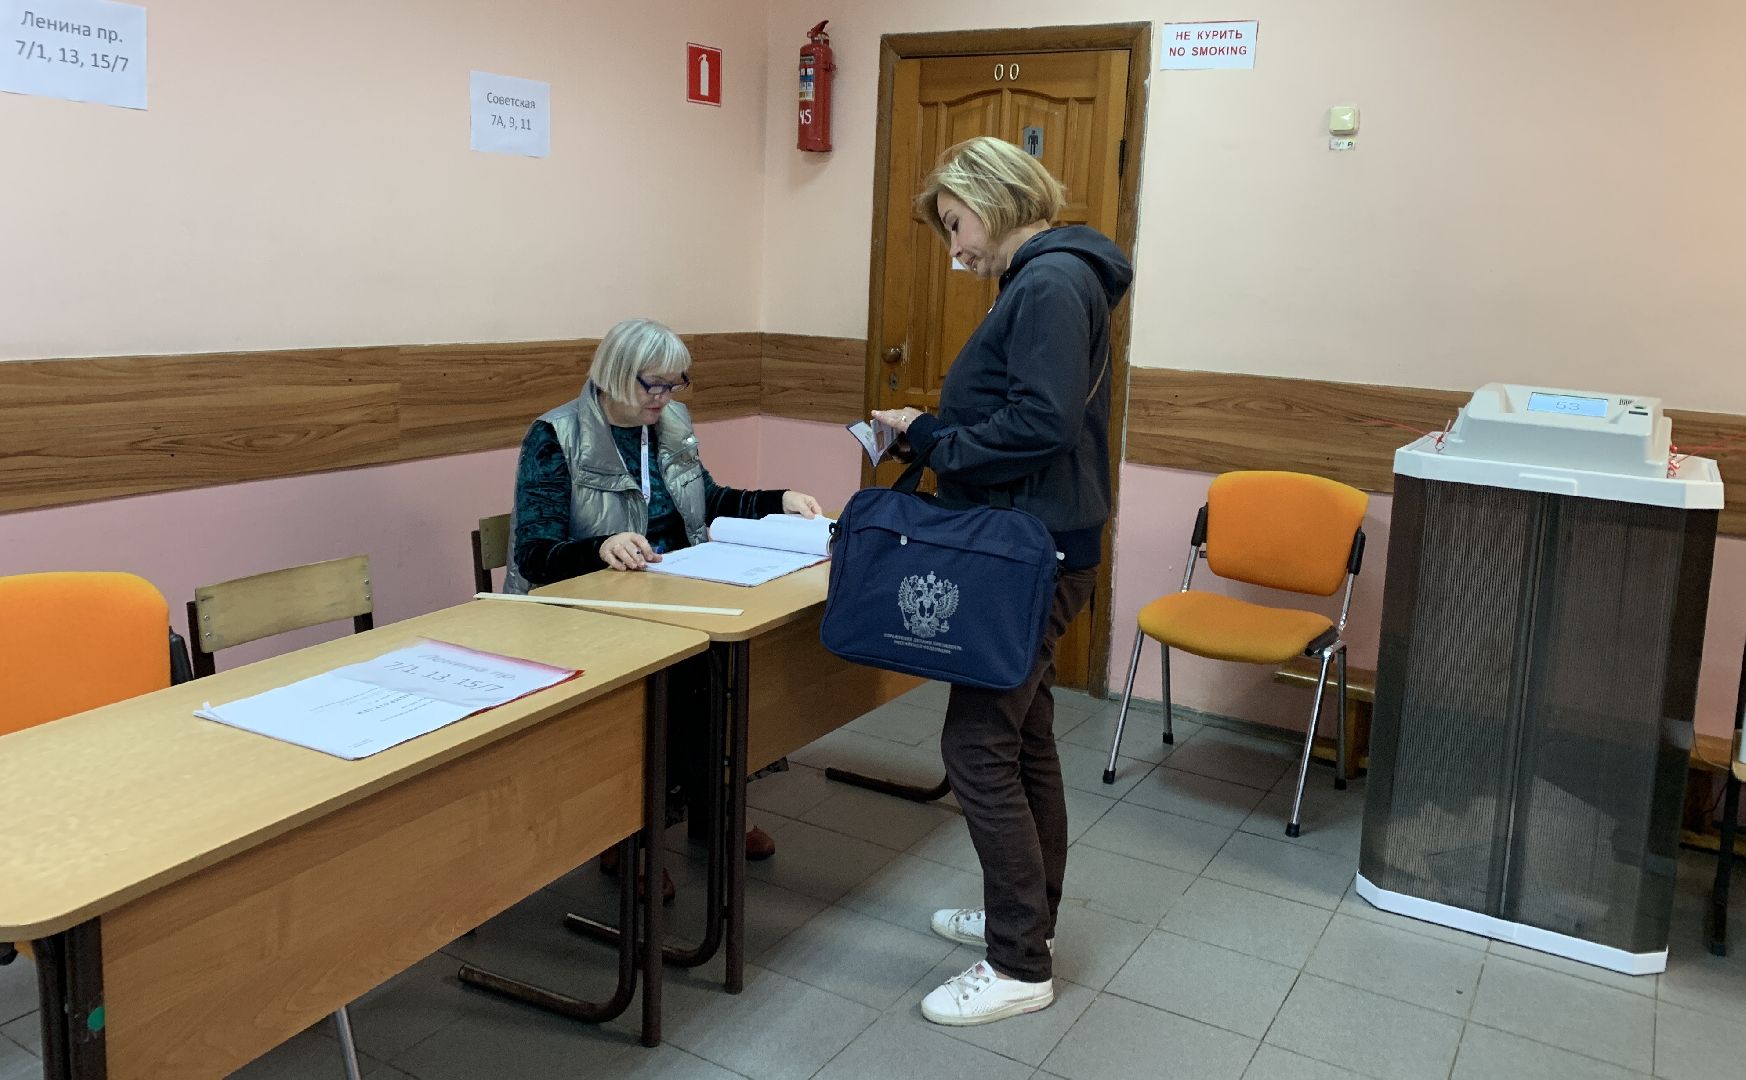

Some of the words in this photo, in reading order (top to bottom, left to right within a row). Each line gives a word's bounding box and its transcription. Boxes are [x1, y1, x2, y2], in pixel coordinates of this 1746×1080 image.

[21, 10, 91, 37] Ленина
[97, 27, 123, 44] пр.
[1175, 31, 1191, 41] НЕ
[1197, 29, 1243, 40] КУРИТЬ
[15, 39, 52, 63] 7/1,
[58, 47, 84, 68] 13,
[90, 53, 129, 73] 15/7
[1169, 46, 1186, 57] NO
[1191, 45, 1247, 56] SMOKING
[486, 91, 536, 109] Советская
[491, 114, 506, 129] 7А,
[509, 116, 518, 131] 9,
[520, 118, 532, 131] 11
[1555, 401, 1580, 411] 53
[452, 678, 505, 692] 15/7
